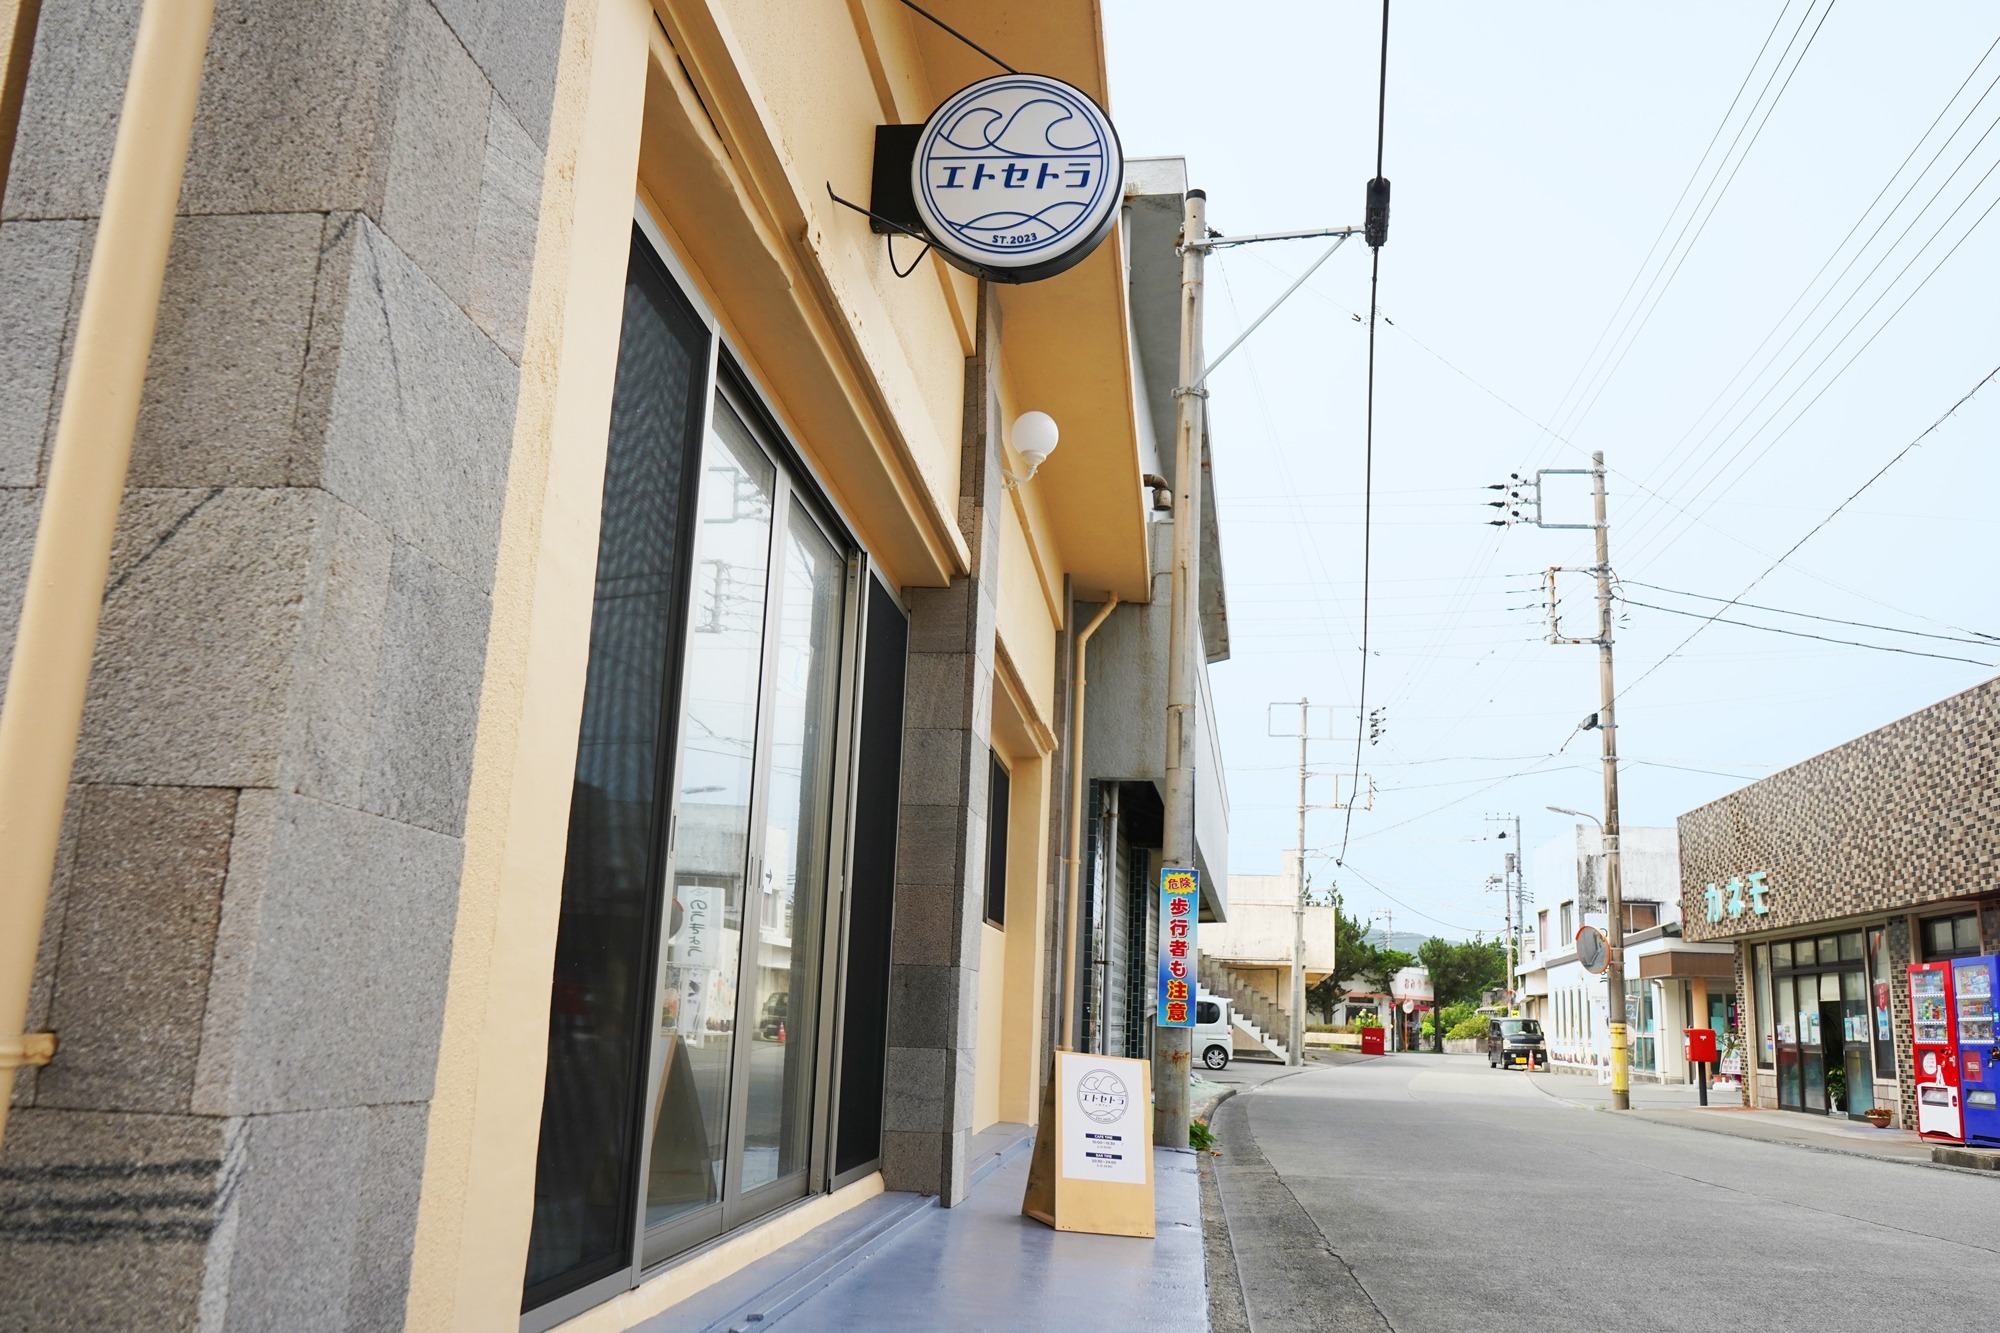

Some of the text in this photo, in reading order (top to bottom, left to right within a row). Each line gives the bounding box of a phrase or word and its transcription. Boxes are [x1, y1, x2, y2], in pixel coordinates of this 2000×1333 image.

[936, 162, 1091, 190] エトセトラ
[1168, 877, 1192, 890] 危険
[1704, 872, 1769, 923] カネモ
[1167, 897, 1190, 1023] 歩行者も注意
[1082, 1094, 1124, 1105] エトセトラ
